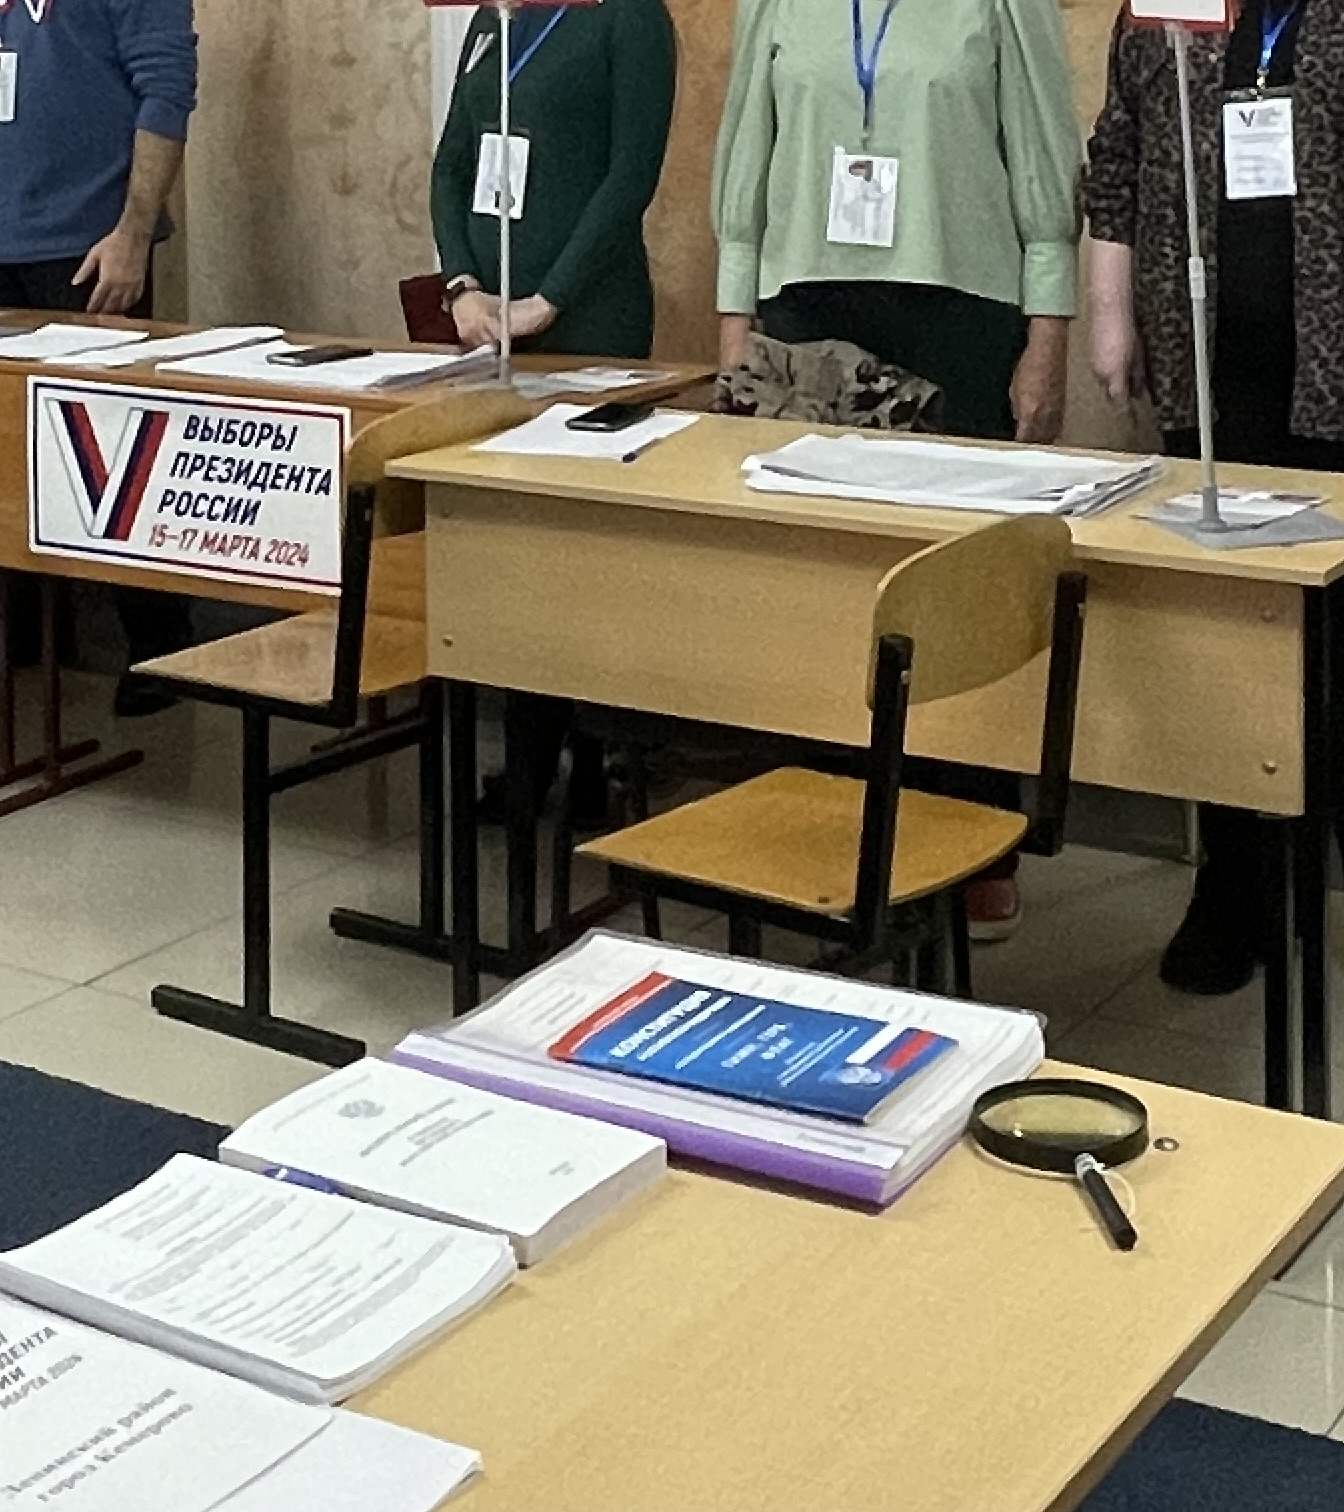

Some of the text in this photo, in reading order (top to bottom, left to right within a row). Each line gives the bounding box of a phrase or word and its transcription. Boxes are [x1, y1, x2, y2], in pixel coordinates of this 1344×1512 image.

[182, 413, 299, 453] ВЫБОРЫ
[168, 451, 333, 496] ПРЕЗИДЕНТА
[156, 488, 262, 526] РОССИИ
[198, 528, 261, 563] МАРТА
[263, 538, 311, 568] 2024
